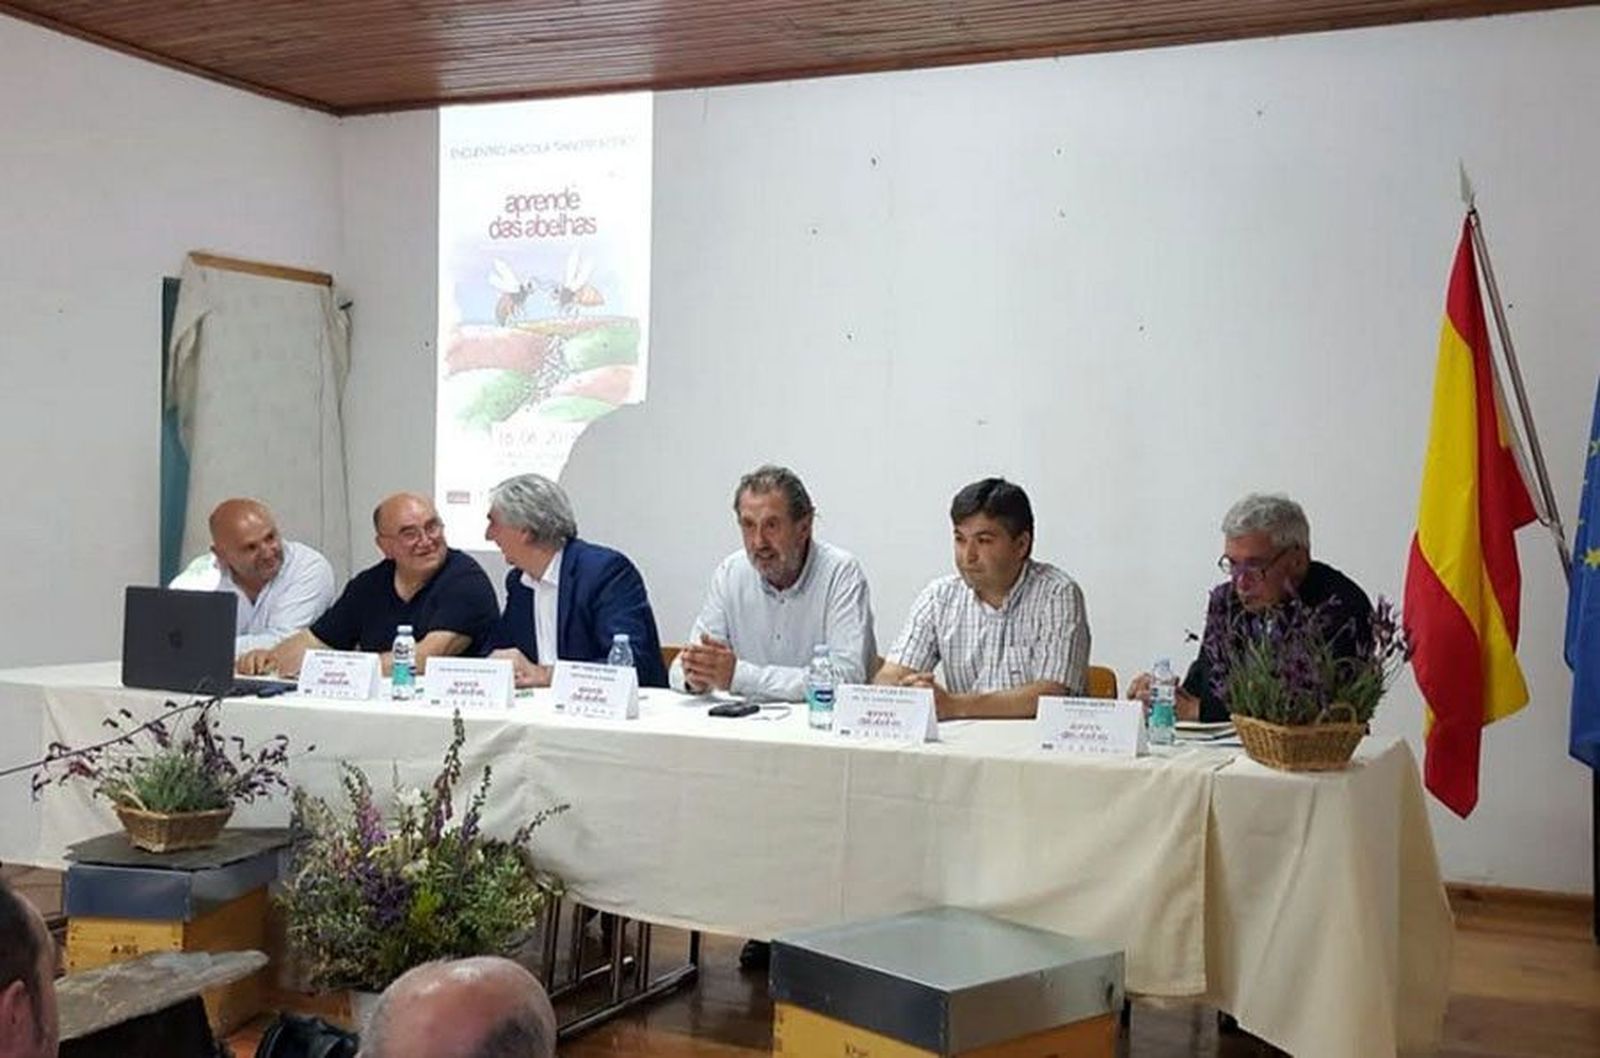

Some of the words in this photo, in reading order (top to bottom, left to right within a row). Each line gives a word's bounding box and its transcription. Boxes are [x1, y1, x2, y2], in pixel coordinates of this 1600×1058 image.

[504, 187, 581, 218] aprende
[488, 216, 523, 240] das
[524, 212, 598, 239] abelhas
